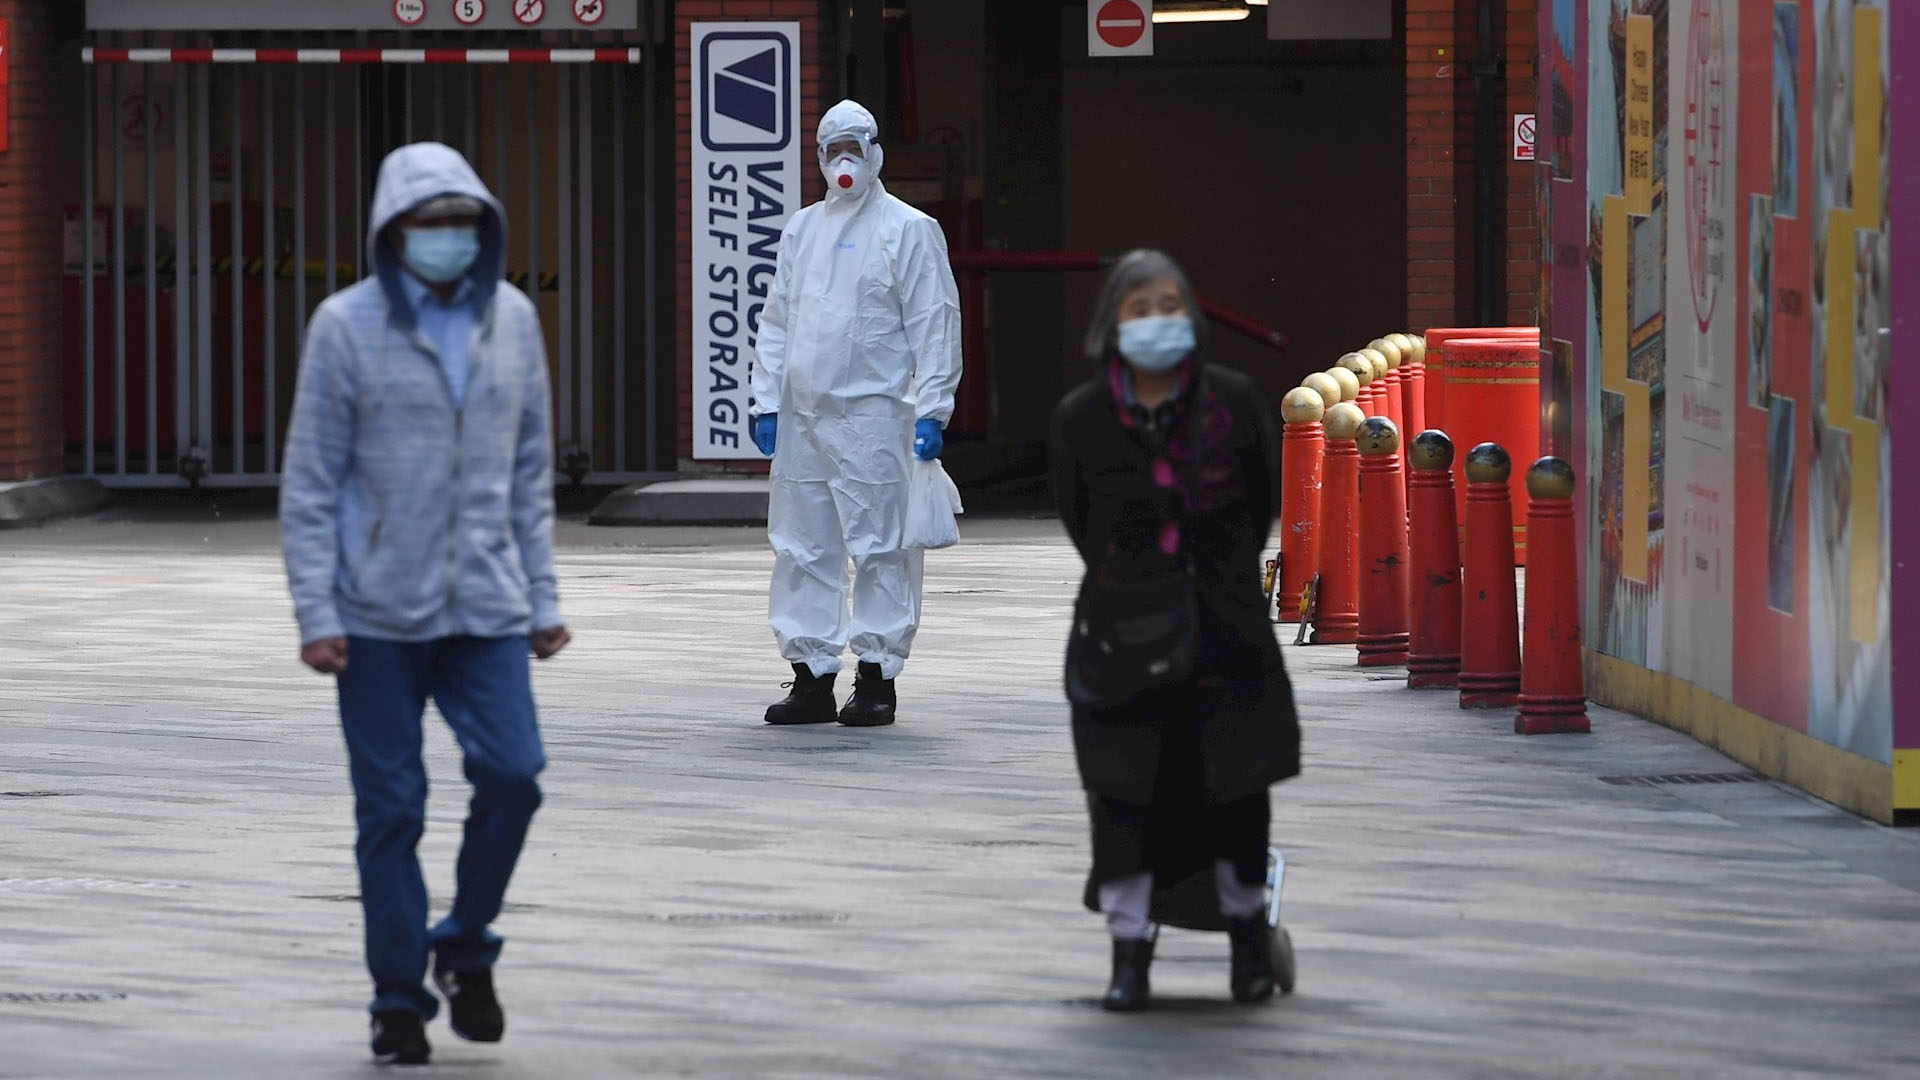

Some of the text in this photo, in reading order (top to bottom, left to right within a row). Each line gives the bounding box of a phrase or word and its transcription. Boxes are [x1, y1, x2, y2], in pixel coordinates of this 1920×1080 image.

[464, 1, 474, 17] 5
[708, 161, 739, 449] SELF STORAGE
[747, 161, 784, 446] VANG
